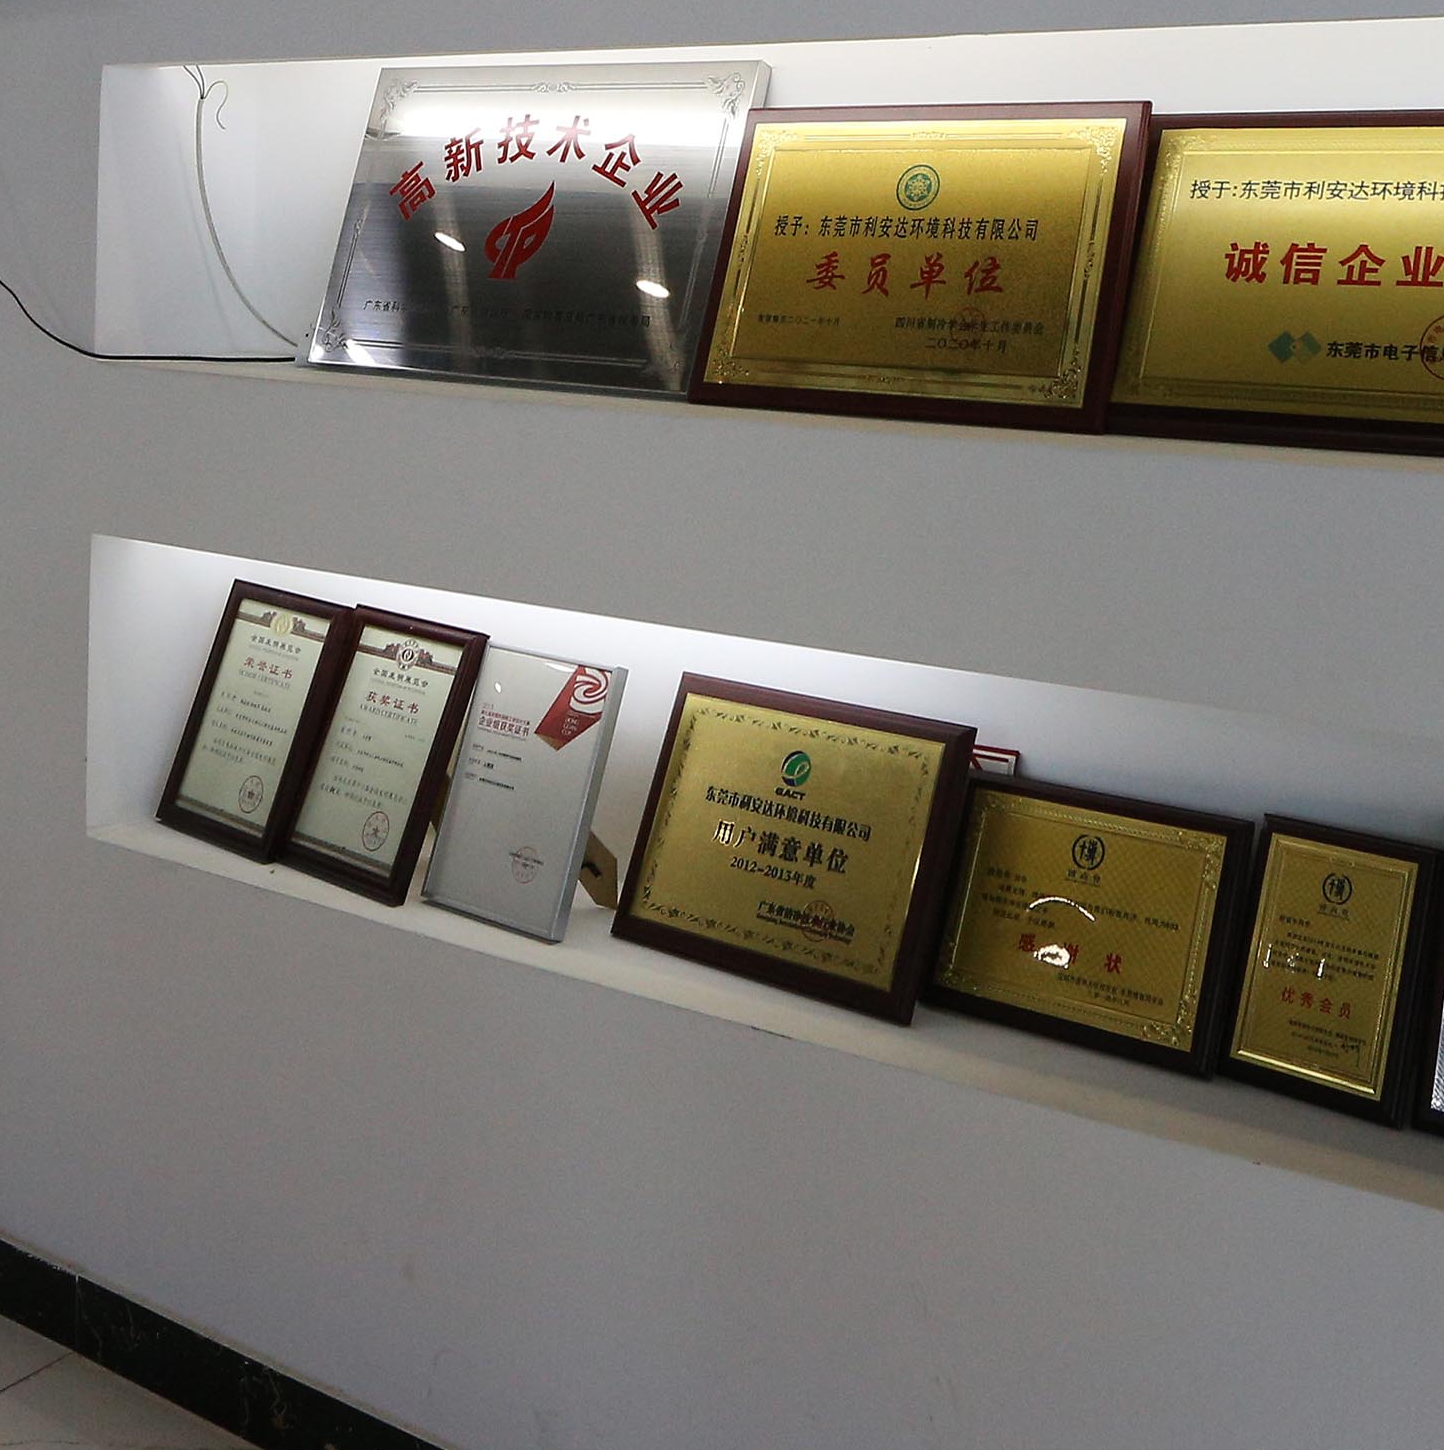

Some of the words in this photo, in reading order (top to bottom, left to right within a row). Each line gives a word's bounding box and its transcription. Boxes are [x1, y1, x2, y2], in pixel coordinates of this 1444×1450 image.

[388, 113, 684, 231] 高新技术企业
[805, 251, 1005, 300] 委员单位
[365, 690, 420, 716] 获奖证书
[704, 785, 872, 842] 东莞市利安达环境科技有限公司
[712, 818, 850, 874] 用户满意单位
[1281, 985, 1353, 1021] 优秀会员
